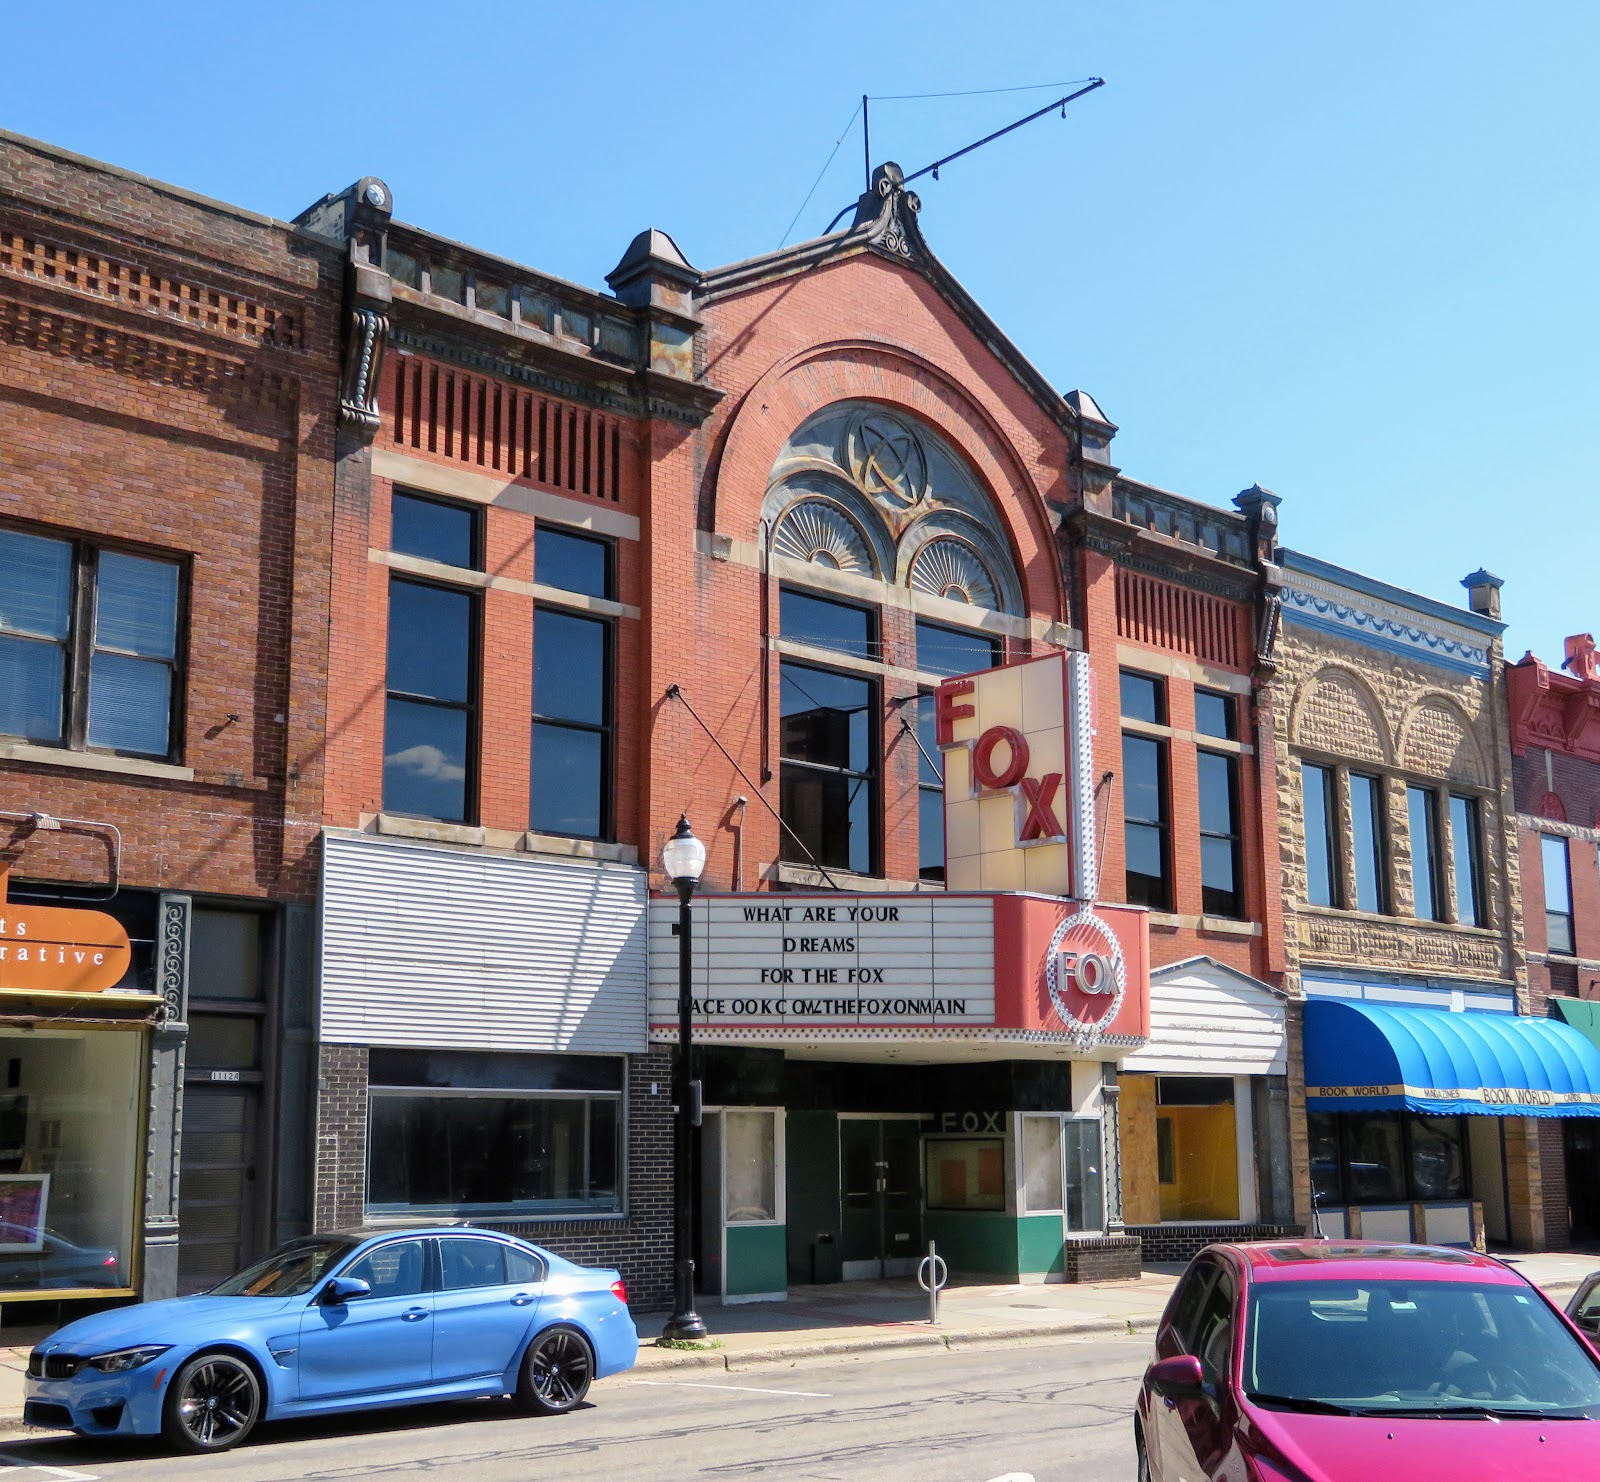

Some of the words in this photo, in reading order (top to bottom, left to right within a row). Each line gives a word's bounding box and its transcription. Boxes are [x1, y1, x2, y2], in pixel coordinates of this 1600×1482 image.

[934, 680, 1065, 841] FOX
[743, 907, 793, 922] WHAT
[802, 907, 836, 922] ARE
[847, 907, 900, 922] YOUR
[783, 937, 855, 952] DREAMS
[0, 946, 104, 966] rative
[761, 968, 794, 983] FOR
[802, 968, 838, 983] THE
[848, 968, 884, 983] FOX
[1056, 951, 1121, 996] FOX
[1319, 1087, 1348, 1096] BOOK
[1352, 1086, 1390, 1096] WORLD
[1424, 1089, 1460, 1099] MAGAZINES
[1483, 1089, 1513, 1104] BOOK
[1514, 1089, 1551, 1105] WORLD
[1563, 1093, 1582, 1103] CARDS
[941, 1111, 999, 1133] FOX
